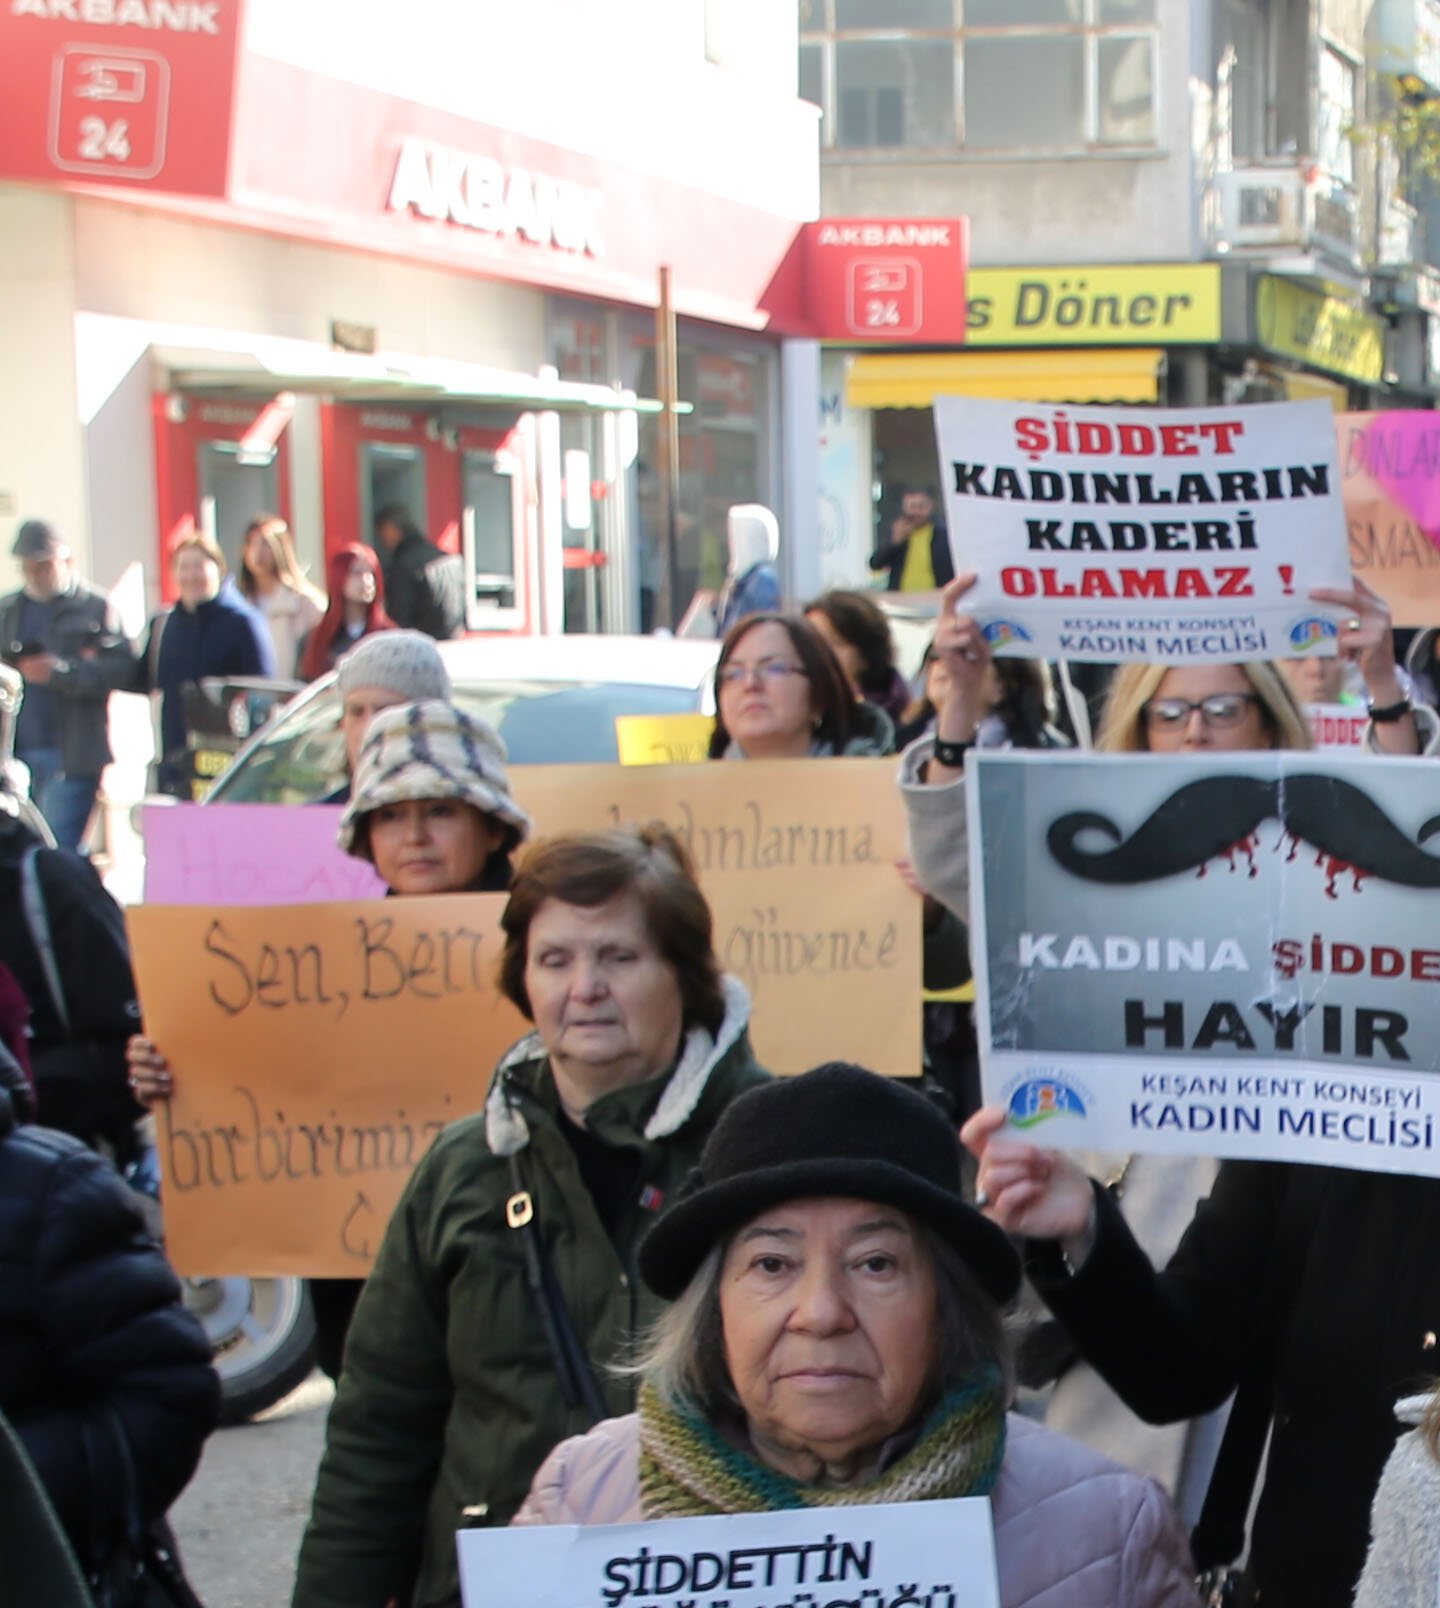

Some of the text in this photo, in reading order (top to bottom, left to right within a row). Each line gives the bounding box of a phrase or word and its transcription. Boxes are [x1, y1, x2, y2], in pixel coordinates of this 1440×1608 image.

[77, 114, 132, 162] 24
[386, 136, 607, 257] AKBANK
[818, 224, 951, 247] AKBANK
[865, 298, 901, 328] 24
[1014, 278, 1193, 329] Döner
[1013, 410, 1245, 461] ŞİDDET
[951, 459, 1331, 505] KADINLARIN
[1024, 510, 1260, 552] KADERİ
[1000, 564, 1296, 599] OLAMAZ !
[1059, 629, 1268, 656] KADIN MECLİSİ
[1125, 617, 1172, 632] KENT
[1017, 931, 1251, 975] KADINA
[1122, 998, 1413, 1063] HAYIR
[1141, 1074, 1423, 1111] KEŞAN KENT KONSEYİ
[1129, 1102, 1262, 1134] KADIN
[1277, 1107, 1435, 1151] MECLİSİ
[600, 1540, 873, 1607] ŞİDDETTİN
